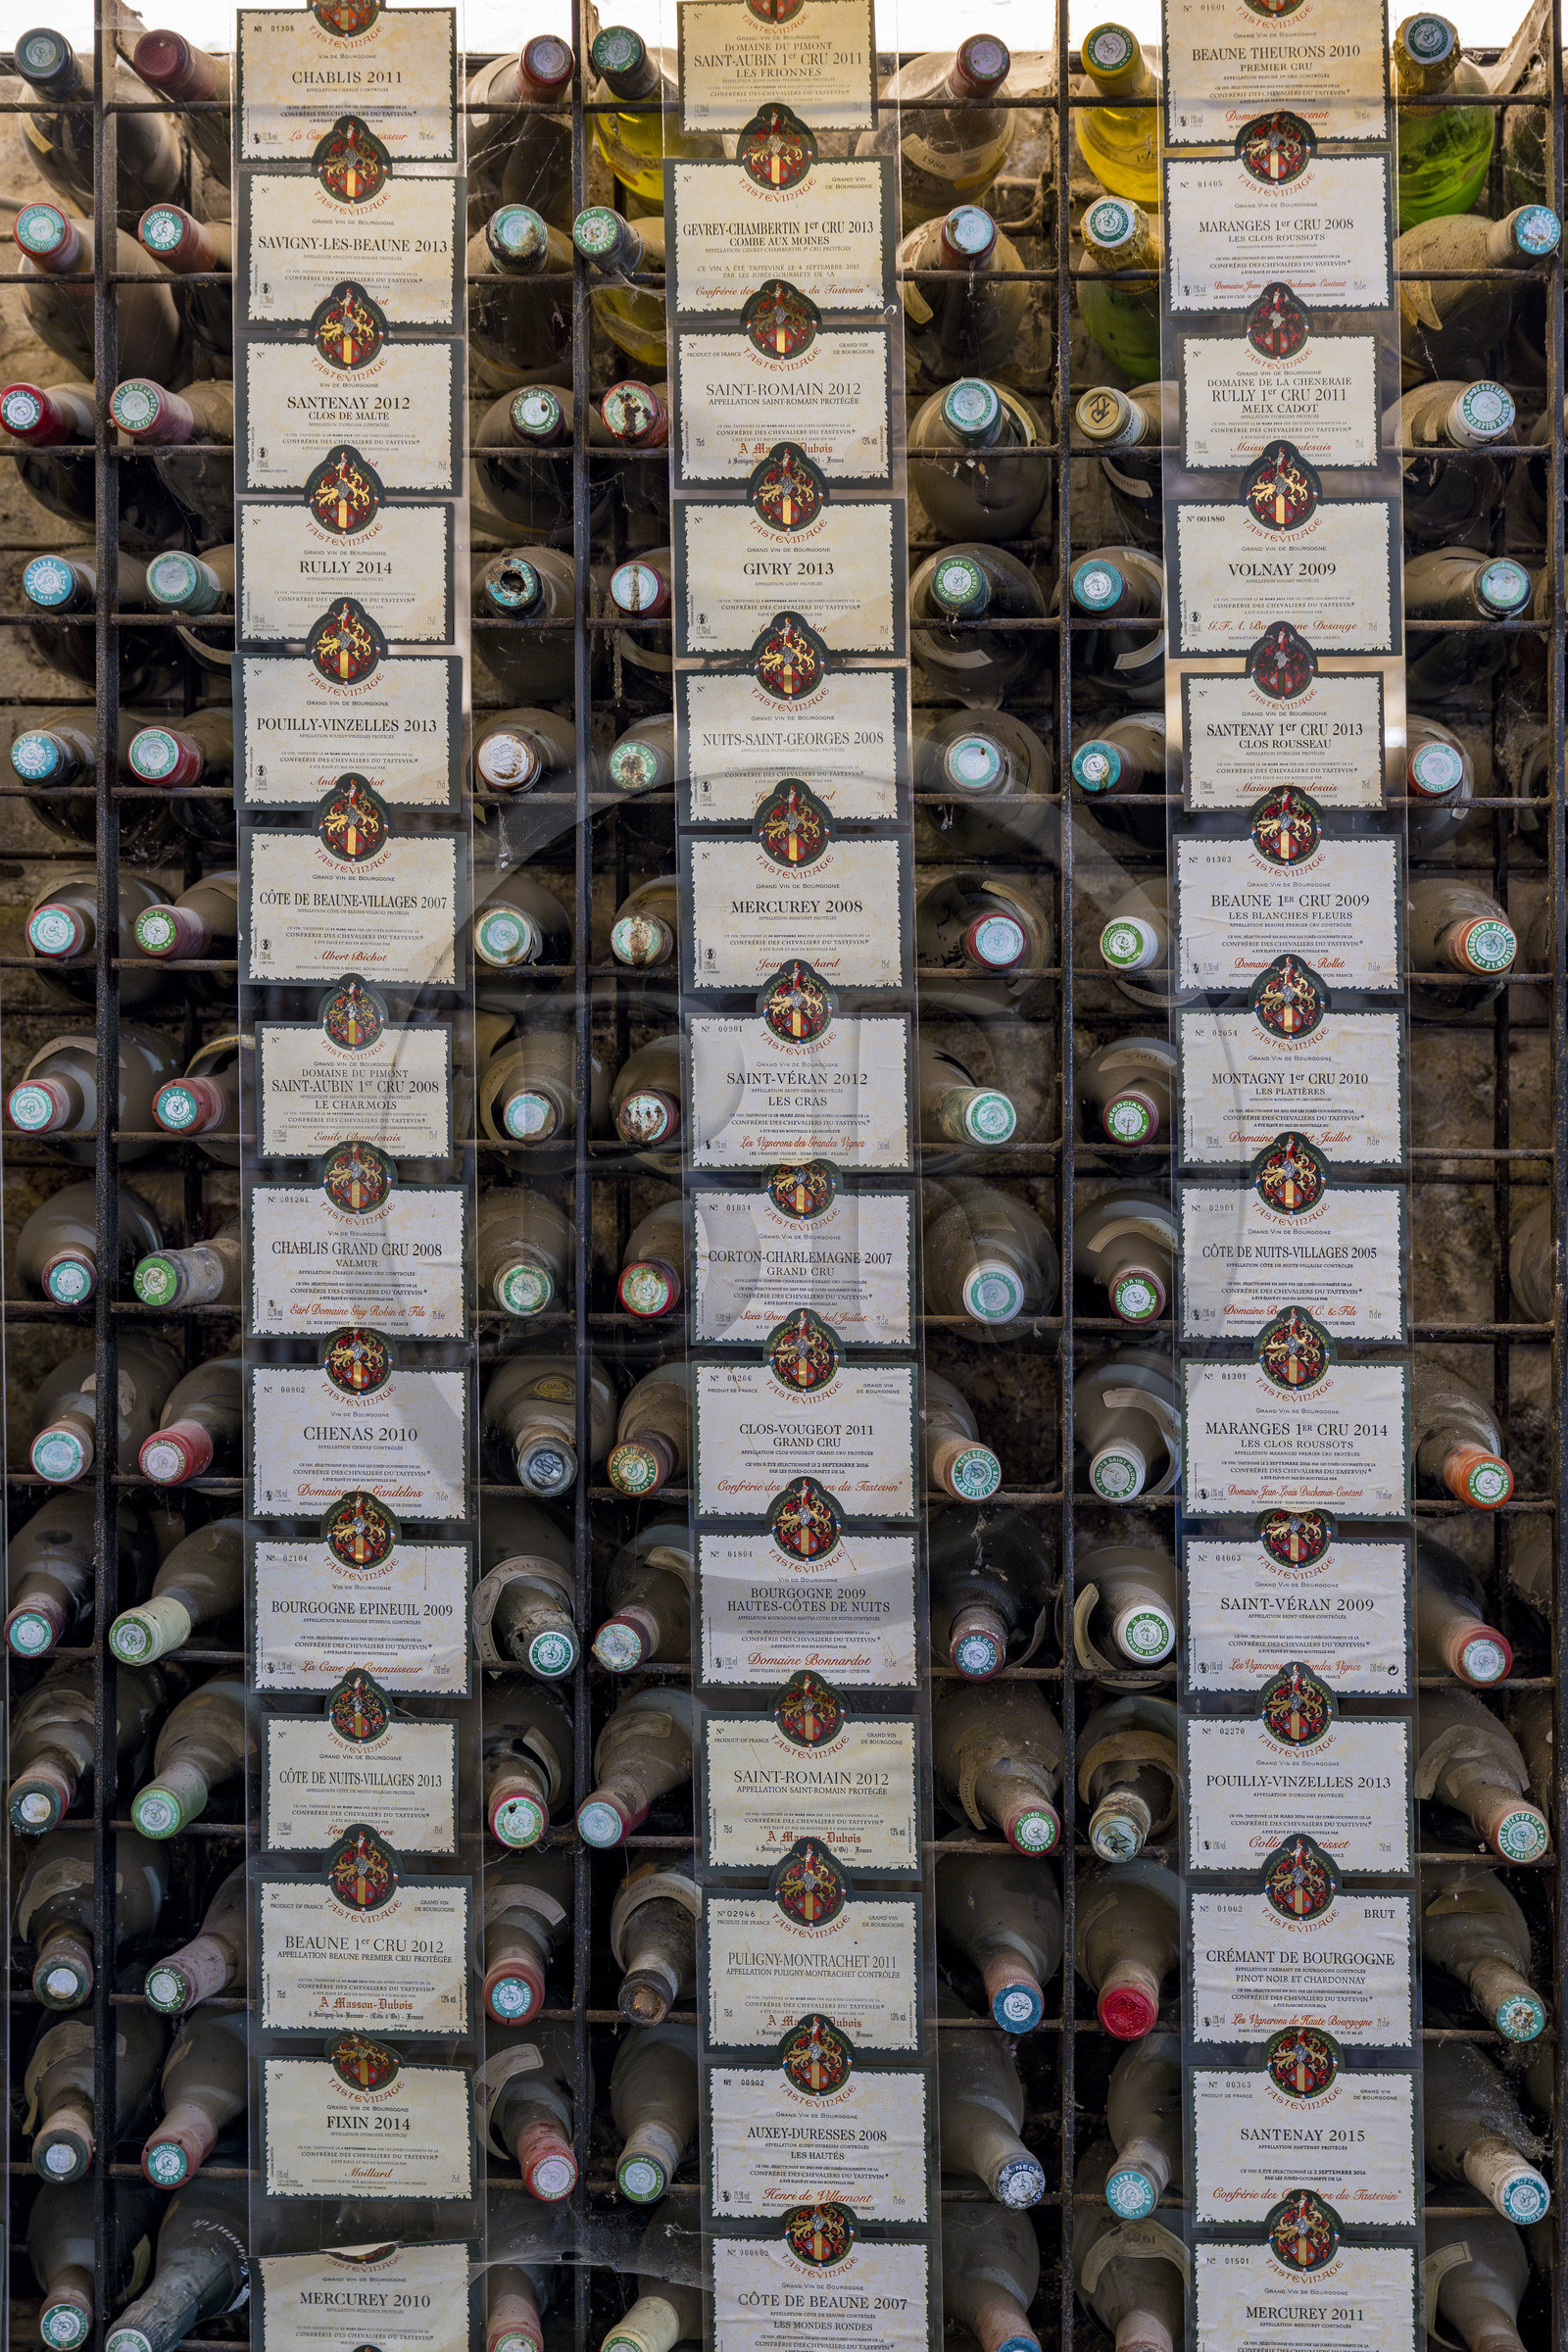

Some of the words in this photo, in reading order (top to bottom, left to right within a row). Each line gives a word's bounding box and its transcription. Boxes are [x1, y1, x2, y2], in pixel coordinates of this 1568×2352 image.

[310, 24, 384, 49] TASTEVINAGE
[694, 54, 776, 67] SAINT-AUBIN
[801, 53, 828, 65] CRU
[833, 52, 861, 65] 2011
[1193, 48, 1247, 61] BEAUNE
[1250, 45, 1325, 59] THEURONS
[1329, 45, 1360, 57] 2010
[1241, 63, 1287, 72] PREMIER
[292, 72, 362, 83] CHABLIS
[368, 72, 401, 83] 2011
[683, 221, 800, 235] GEVREY-CHAMBERTIN
[821, 221, 845, 233] CRU
[849, 220, 873, 233] 2013
[1200, 220, 1271, 232] MARANGES
[1294, 219, 1321, 230] CRU
[1325, 219, 1353, 229] 2008
[259, 236, 410, 252] SAVIGNY-LES-BEAUNE
[415, 240, 447, 253] 2013
[707, 383, 823, 396] SAINT-ROMAIN
[828, 383, 860, 395] 2012
[1212, 389, 1256, 402] RULLY
[1281, 388, 1310, 401] CRU
[1315, 388, 1346, 401] 2011
[287, 397, 368, 409] SANTENAY
[374, 397, 410, 410] 2012
[1242, 404, 1273, 414] MEIX
[1277, 404, 1318, 414] CADOT
[356, 412, 389, 420] MALTE
[750, 518, 828, 544] TASTEVINAGE
[300, 561, 351, 573] RULLY
[356, 562, 392, 574] 2014
[744, 563, 792, 575] GIVRY
[798, 563, 834, 575] 2013
[1228, 564, 1294, 576] VOLNAY
[1298, 564, 1336, 575] 2009
[258, 718, 399, 731] POUILLY-VINZELLES
[404, 719, 437, 732] 2013
[1207, 723, 1275, 736] SANTENAY
[1300, 723, 1328, 736] CRU
[1333, 723, 1363, 736] 2013
[703, 732, 850, 746] NUITS-SAINT-GEORGES
[854, 731, 884, 744] 2008
[1239, 740, 1269, 749] CLOS
[1272, 739, 1332, 749] ROUSSEAU
[260, 889, 291, 905] CÔTE
[294, 893, 310, 906] DE
[314, 894, 417, 908] BEAUNE-VILLAGES
[420, 896, 447, 908] 2007
[1211, 895, 1272, 906] BEAUNE
[1298, 895, 1331, 906] CRU
[1336, 895, 1369, 906] 2009
[732, 901, 820, 913] MERCUREY
[825, 901, 862, 912] 2008
[315, 951, 350, 960] Albert
[351, 952, 387, 961] Bichot
[727, 1070, 828, 1085] SAINT-VÉRAN
[833, 1073, 867, 1085] 2012
[1212, 1072, 1285, 1084] MONTAGNY
[1308, 1073, 1336, 1085] CRU
[1339, 1073, 1368, 1084] 2010
[272, 1079, 353, 1093] SAINT-AUBIN
[377, 1079, 405, 1093] CRU
[409, 1081, 439, 1093] 2008
[768, 1097, 791, 1106] LES
[795, 1097, 827, 1106] CRAS
[271, 1241, 328, 1254] CHABLIS
[331, 1242, 377, 1255] GRAND
[381, 1243, 410, 1256] CRU
[413, 1244, 442, 1256] 2008
[1202, 1243, 1234, 1257] CÔTE
[1237, 1246, 1252, 1258] DE
[1254, 1247, 1348, 1259] NUITS-VILLAGES
[1351, 1247, 1377, 1258] 2005
[708, 1250, 860, 1264] CORTON-CHARLEMAGNE
[864, 1252, 892, 1264] 2007
[304, 1427, 373, 1441] CHENAS
[378, 1428, 417, 1442] 2010
[739, 1424, 842, 1435] CLOS-VOUGEOT
[846, 1425, 873, 1435] 2011
[1205, 1422, 1290, 1435] MARANGES
[1317, 1424, 1348, 1436] CRU
[1353, 1424, 1388, 1436] 2014
[751, 1588, 833, 1598] BOURGOGNE
[837, 1589, 866, 1599] 2009
[271, 1600, 356, 1614] BOURGOGNE
[360, 1602, 419, 1616] EPINEUIL
[423, 1604, 453, 1616] 2009
[727, 1598, 826, 1612] HAUTES-CÔTES
[830, 1601, 848, 1612] DE
[851, 1601, 890, 1612] NUITS
[1221, 1595, 1331, 1611] SAINT-VÉRAN
[1337, 1598, 1374, 1611] 2009
[279, 1767, 309, 1784] CÔTE
[312, 1771, 326, 1784] DE
[329, 1772, 415, 1787] NUITS-VILLAGES
[417, 1774, 442, 1788] 2013
[734, 1770, 851, 1785] SAINT-ROMAIN
[857, 1773, 889, 1786] 2012
[1206, 1775, 1353, 1788] POUILLY-VINZELLES
[1357, 1777, 1391, 1788] 2013
[1364, 1909, 1396, 1919] BRUT
[285, 1936, 349, 1950] BEAUNE
[373, 1938, 407, 1952] CRU
[411, 1940, 443, 1953] 2012
[729, 1952, 870, 1968] PULIGNY-MONTRACHET
[872, 1956, 896, 1969] 2011
[1206, 1947, 1275, 1963] CRÉMANT
[1280, 1951, 1298, 1964] DE
[1302, 1952, 1395, 1965] BOURGOGNE
[327, 2116, 368, 2129] FIXIN
[374, 2117, 411, 2131] 2014
[747, 2127, 856, 2140] AUXEY-DURESSES
[858, 2130, 887, 2141] 2008
[1241, 2129, 1323, 2141] SANTENAY
[1329, 2130, 1365, 2141] 2015
[345, 2167, 393, 2178] Moillard
[300, 2292, 388, 2306] MERCUREY
[393, 2294, 430, 2308] 2010
[738, 2291, 780, 2306] CÔTE
[784, 2295, 805, 2307] DE
[809, 2295, 869, 2309] BEAUNE
[874, 2297, 907, 2310] 2007
[1247, 2306, 1327, 2320] MERCUREY
[1332, 2308, 1364, 2321] 2011
